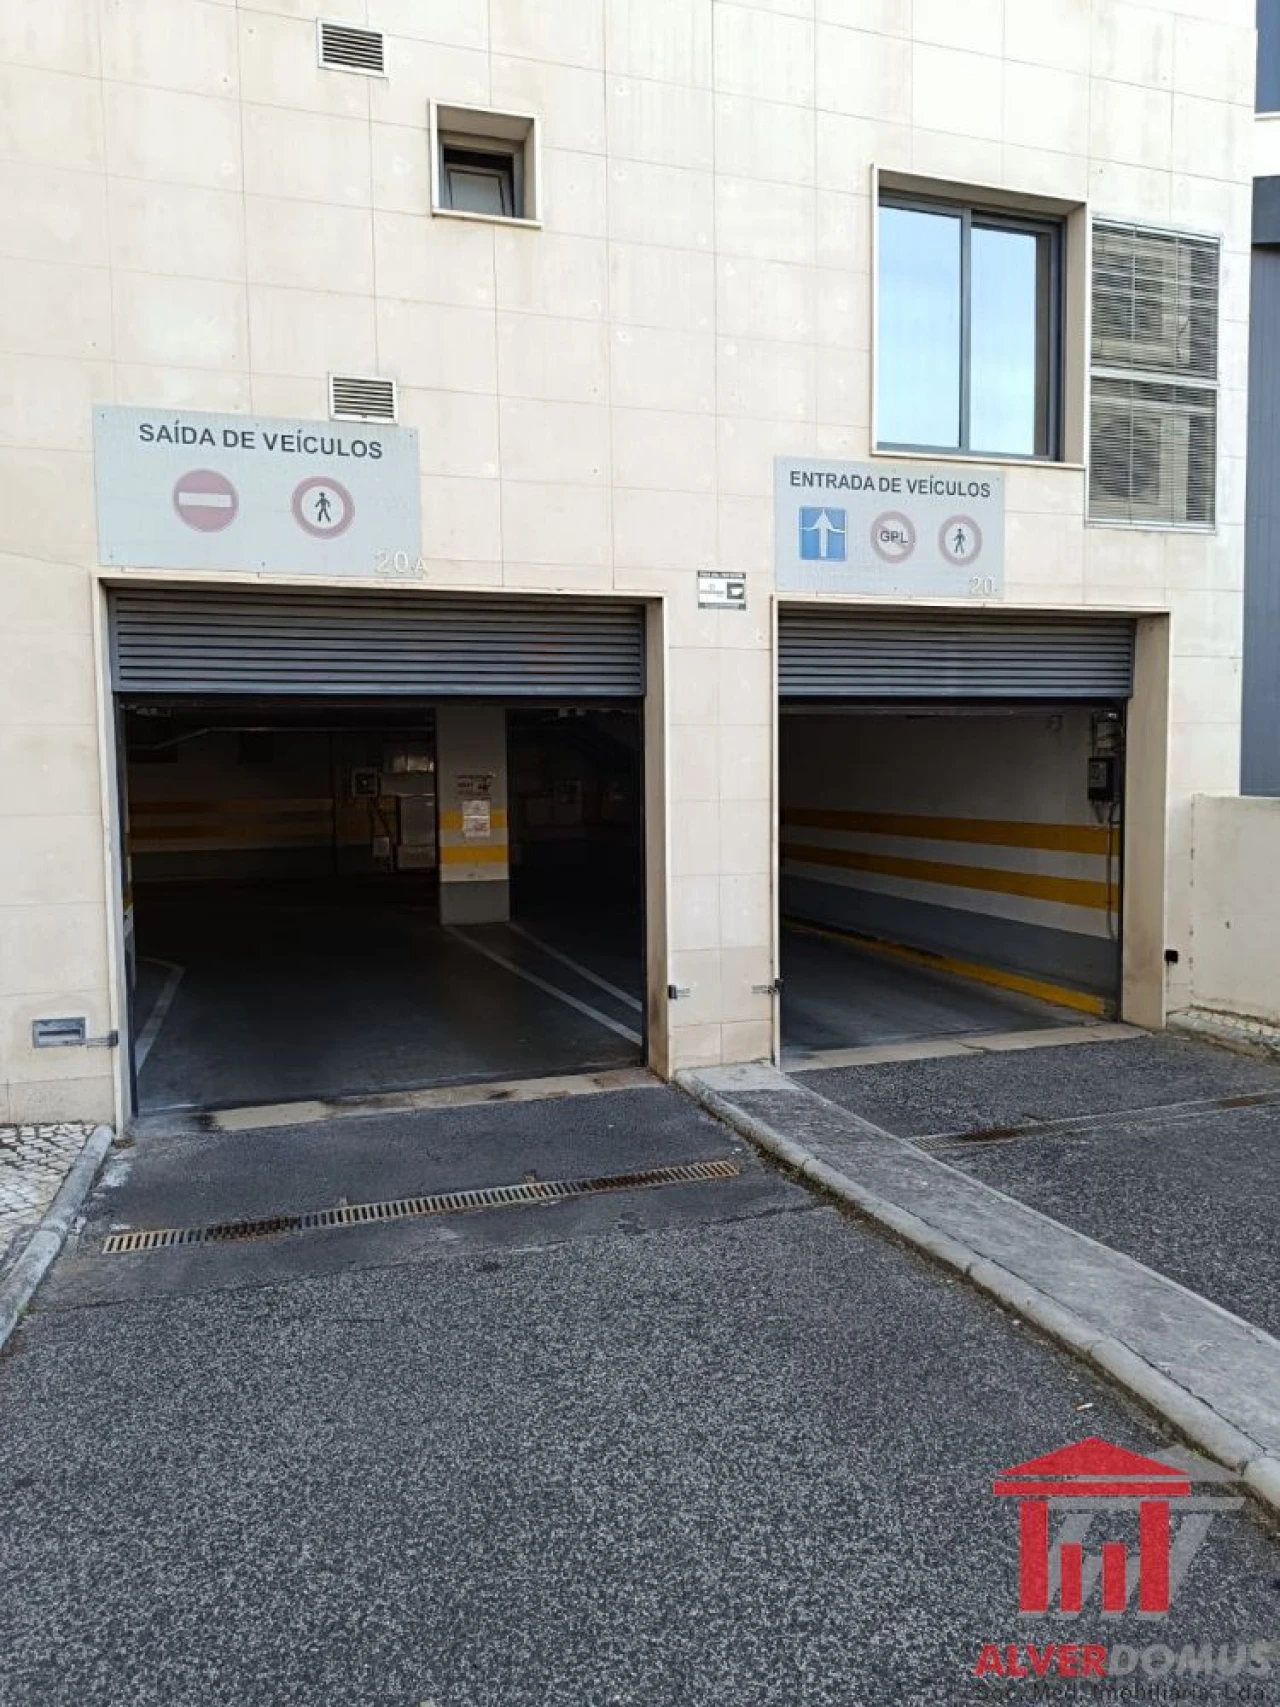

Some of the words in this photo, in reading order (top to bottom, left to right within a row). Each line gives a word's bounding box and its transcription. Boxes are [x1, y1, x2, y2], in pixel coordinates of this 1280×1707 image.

[138, 420, 216, 447] SAÍDA
[222, 429, 256, 450] DE
[262, 429, 383, 460] VEÍCULOS
[790, 470, 875, 492] ENTRADA
[878, 477, 901, 493] DE
[906, 474, 991, 498] VEÍCULOS
[880, 530, 909, 544] GPL
